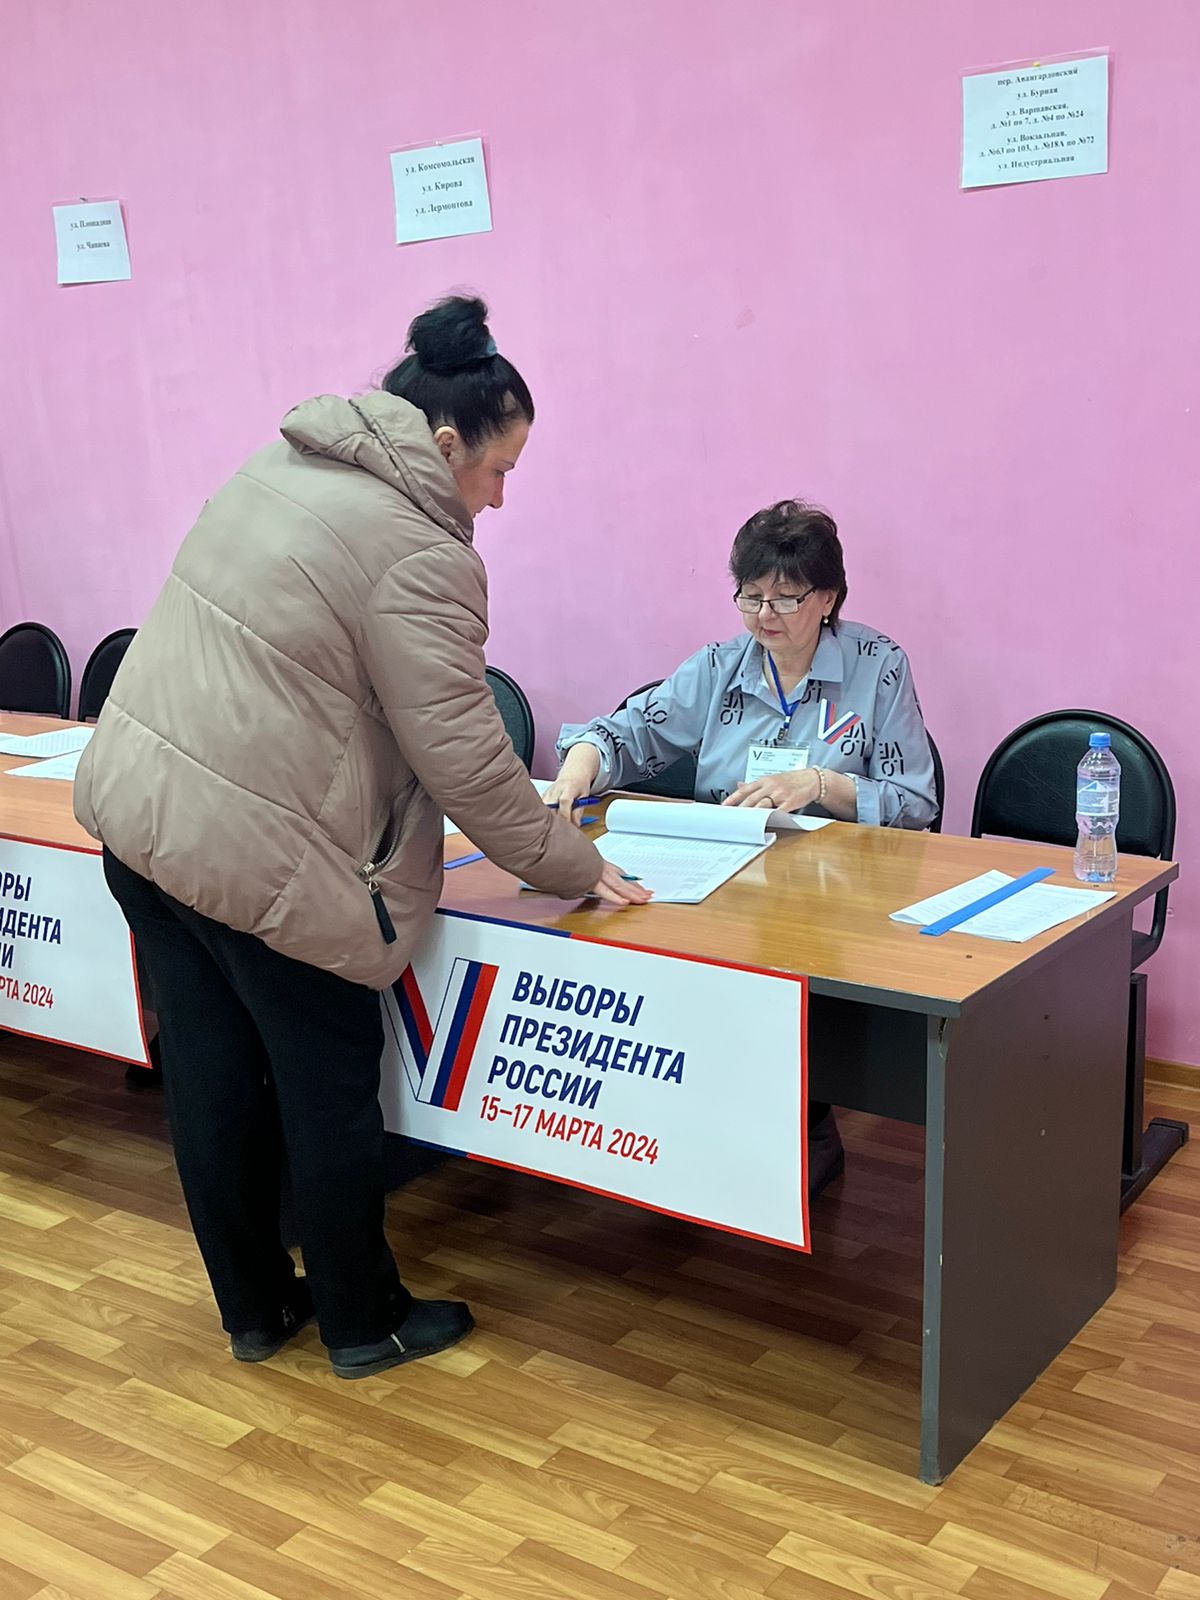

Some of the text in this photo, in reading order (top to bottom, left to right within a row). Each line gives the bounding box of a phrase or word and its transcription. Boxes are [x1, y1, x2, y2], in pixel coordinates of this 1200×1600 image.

[1017, 87, 1058, 100] ул. Бурная
[1006, 110, 1017, 118] ул.
[1055, 113, 1065, 121] по
[1067, 110, 1084, 120] №24
[1006, 137, 1018, 145] ул.
[1077, 136, 1095, 145] №72
[405, 156, 474, 176] ул. Комсомольская
[998, 163, 1009, 171] ул.
[422, 180, 463, 195] ул. Кирова
[415, 200, 473, 216] ул. Лермонтова
[0, 871, 32, 902] РЫ
[22, 982, 54, 1009] 2024
[511, 970, 645, 1026] ВЫБОРЫ
[498, 1012, 687, 1085] ПРЕЗИДЕНТА
[486, 1055, 604, 1110] РОССИИ
[535, 1108, 604, 1151] МАРТА
[606, 1127, 660, 1166] 2024
